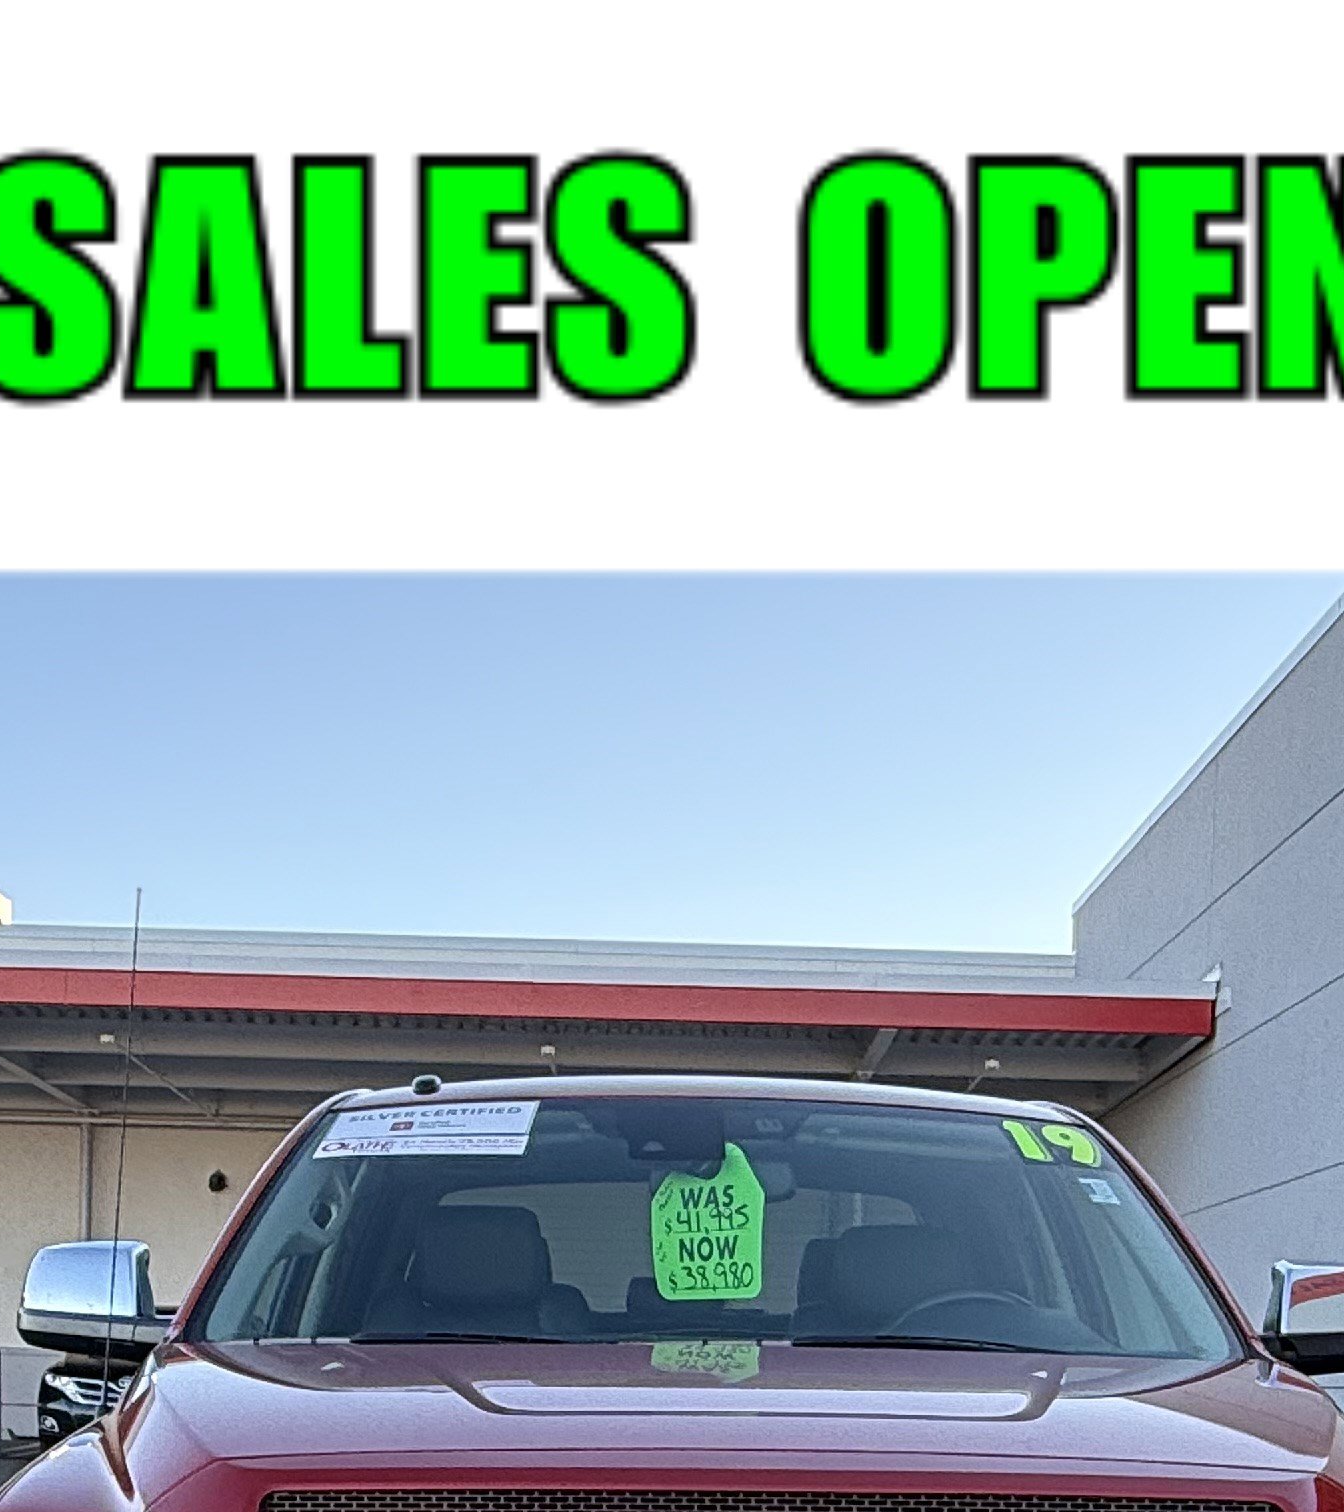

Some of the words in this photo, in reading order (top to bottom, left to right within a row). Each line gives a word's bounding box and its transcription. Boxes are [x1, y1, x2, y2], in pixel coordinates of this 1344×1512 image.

[420, 1106, 522, 1118] CERTIFIED
[1002, 1120, 1101, 1167] 19
[680, 1184, 734, 1209] WAS
[678, 1234, 739, 1262] NOW
